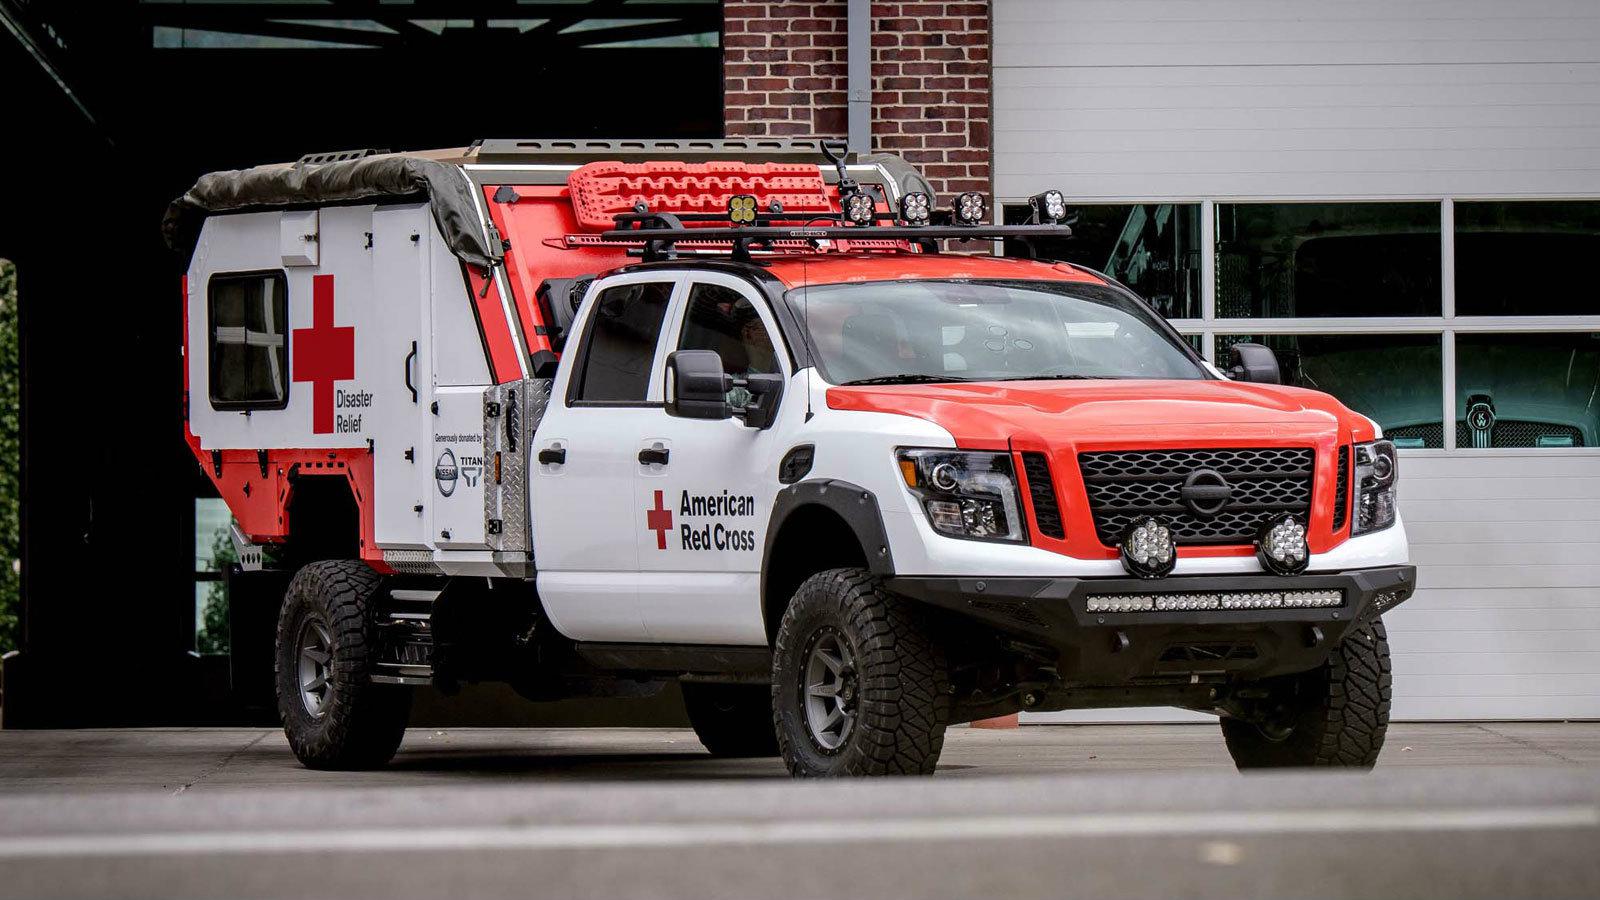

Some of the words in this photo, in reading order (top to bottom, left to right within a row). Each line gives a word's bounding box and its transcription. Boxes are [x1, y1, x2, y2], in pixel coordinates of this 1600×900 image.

[336, 389, 373, 408] Disaster
[336, 414, 362, 433] Relief
[435, 433, 458, 444] Generously
[458, 433, 476, 443] donated
[476, 433, 482, 444] by
[460, 456, 483, 466] TITAN
[437, 468, 456, 477] NISSAN
[680, 489, 754, 516] American
[680, 523, 711, 551] Red
[714, 523, 755, 551] Cross
